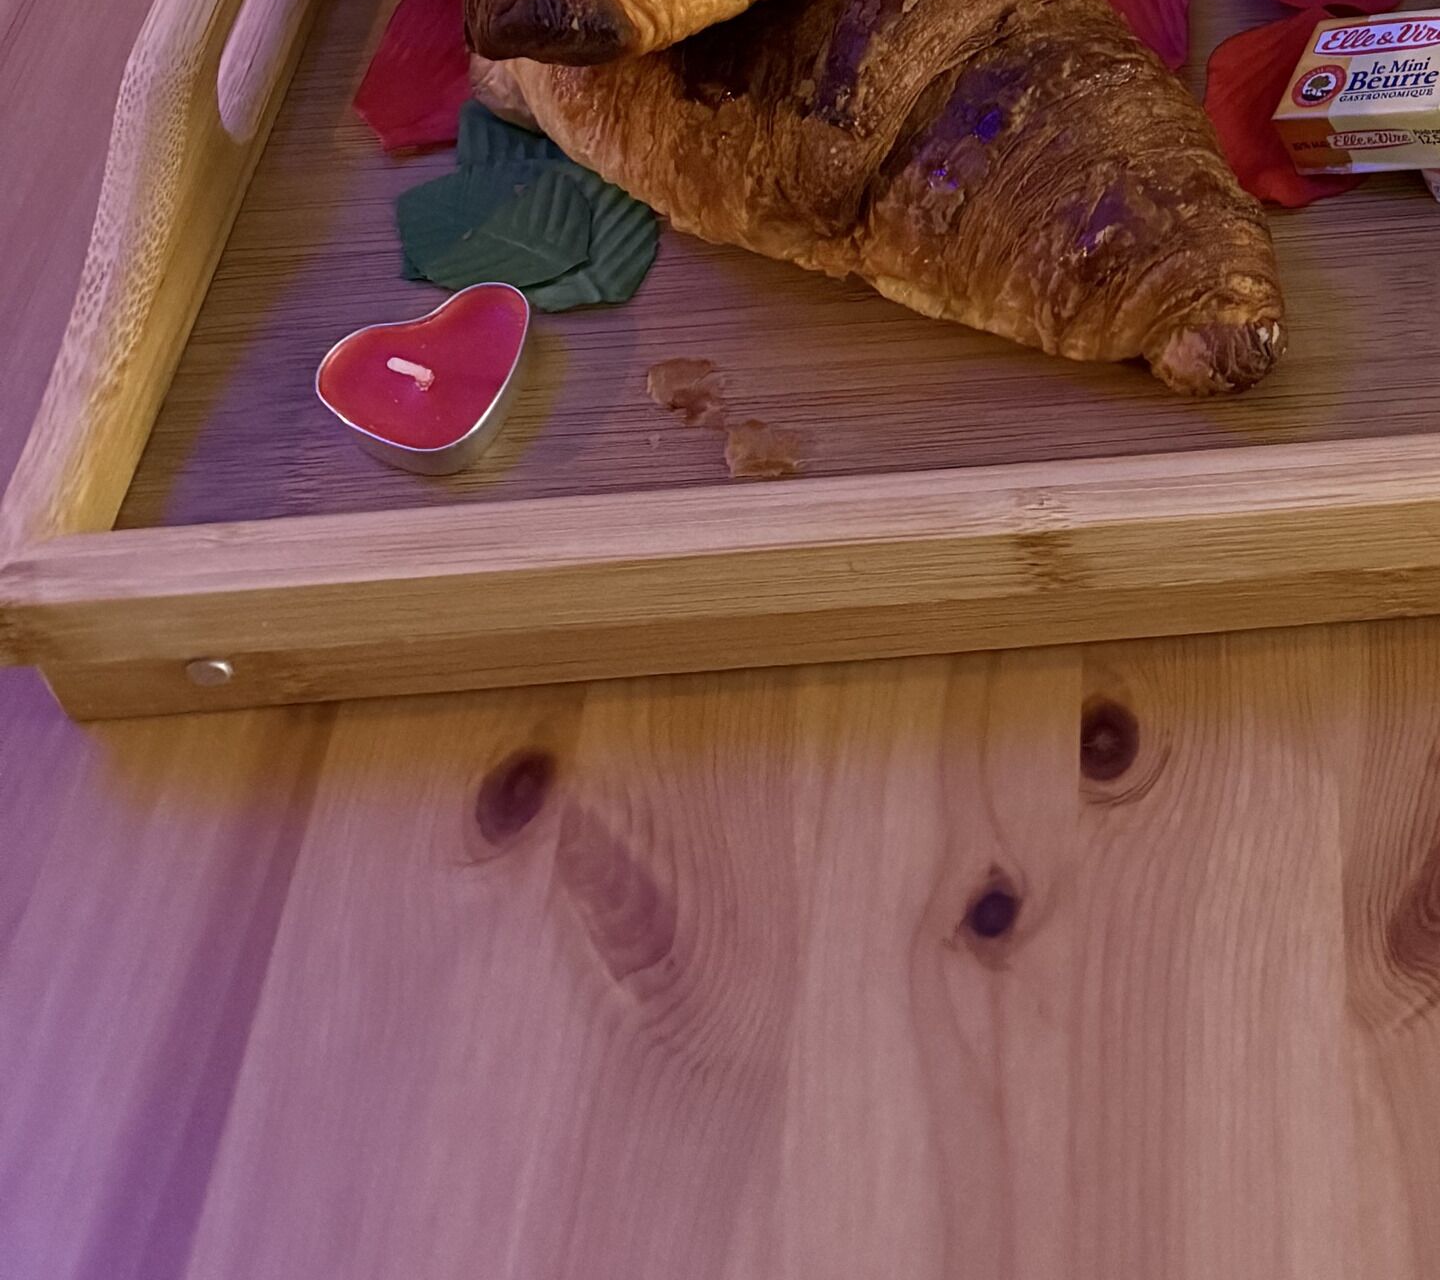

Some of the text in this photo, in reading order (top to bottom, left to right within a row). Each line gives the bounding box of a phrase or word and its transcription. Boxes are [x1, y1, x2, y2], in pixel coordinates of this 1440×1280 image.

[1321, 29, 1376, 51] Elle
[1377, 31, 1394, 45] &
[1371, 57, 1432, 76] le Mini
[1345, 70, 1440, 92] Beurre
[1338, 88, 1434, 103] GASTRONOMIQUE
[1334, 133, 1365, 146] Elle
[1375, 132, 1411, 144] Vire
